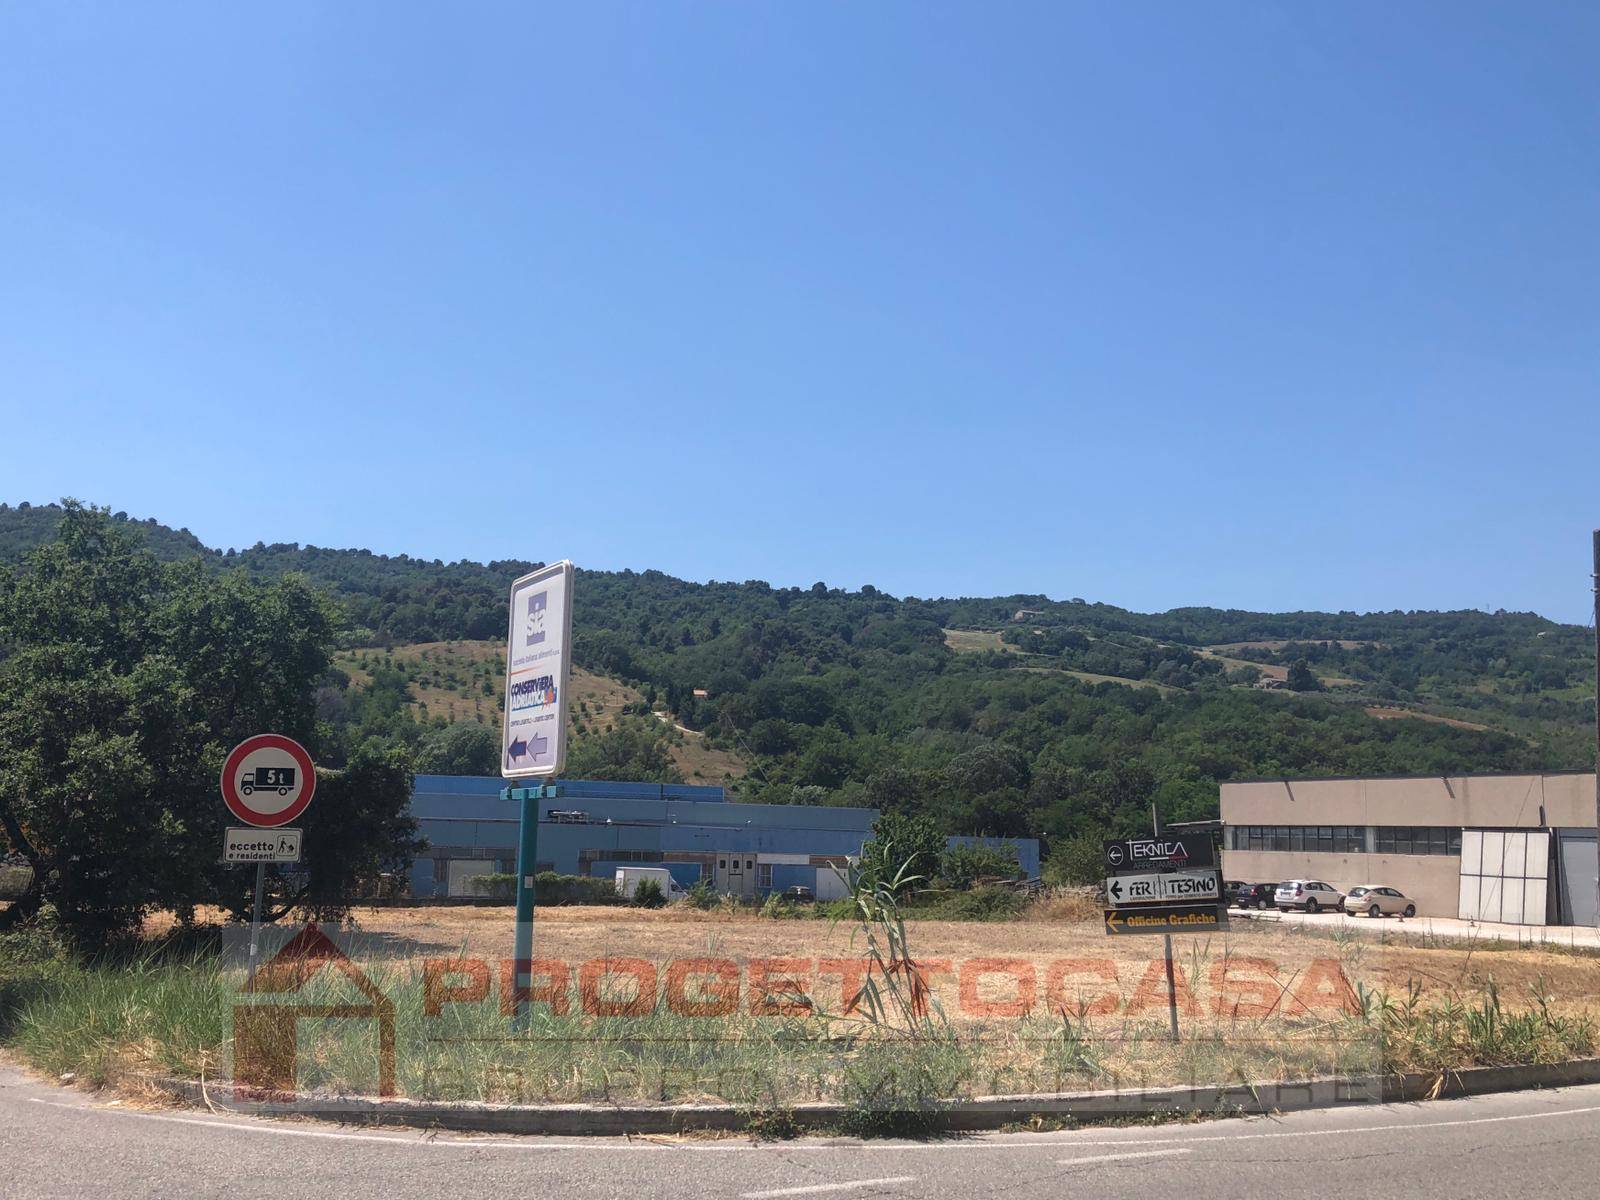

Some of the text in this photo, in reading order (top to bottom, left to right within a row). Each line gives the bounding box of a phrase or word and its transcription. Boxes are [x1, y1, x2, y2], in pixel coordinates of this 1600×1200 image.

[511, 675, 554, 697] CONSERVIERA
[229, 841, 275, 852] eccetto
[236, 851, 276, 861] residenti
[1129, 882, 1152, 896] FER
[1168, 877, 1216, 896] TESINO
[1126, 913, 1216, 927] Officine Grafiche
